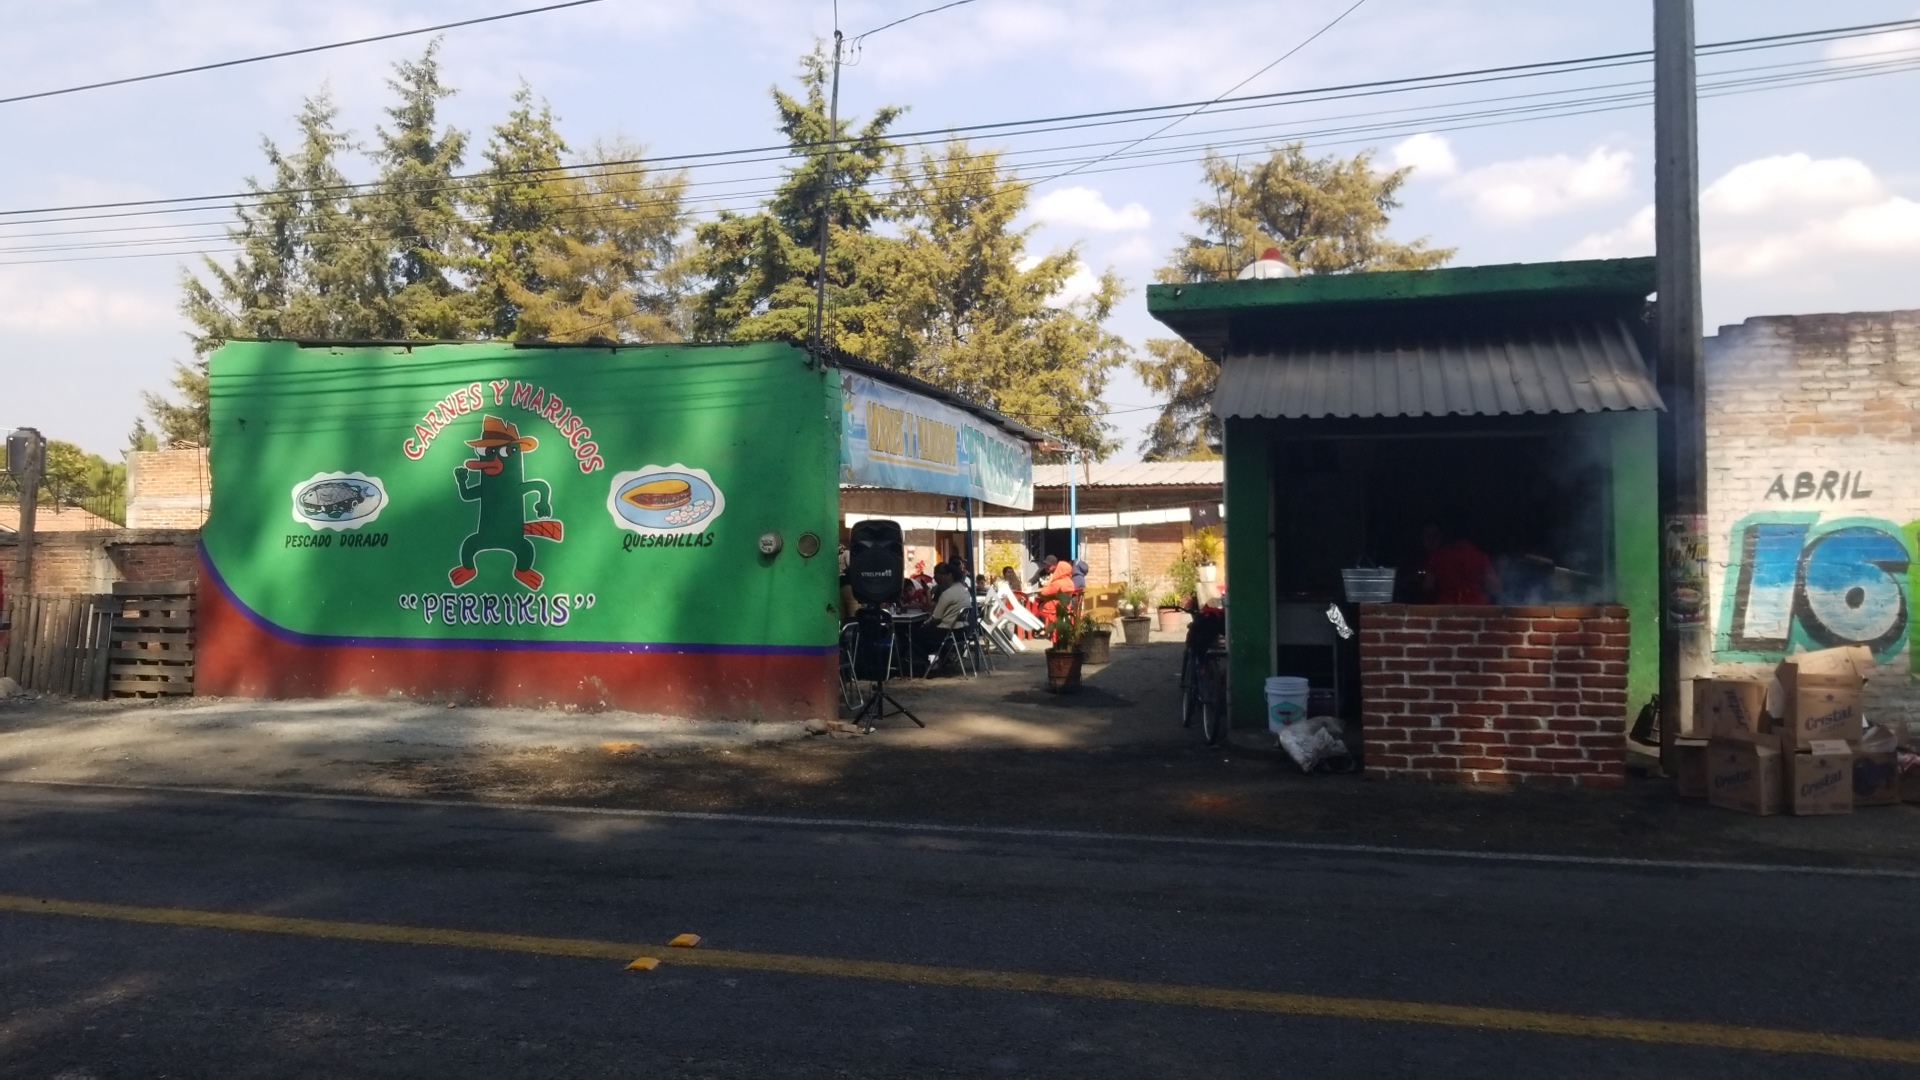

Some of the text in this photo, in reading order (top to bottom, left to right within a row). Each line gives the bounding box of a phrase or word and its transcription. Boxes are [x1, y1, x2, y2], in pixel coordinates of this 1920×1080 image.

[403, 379, 604, 474] CARNES Y MARISCOS
[1764, 470, 1873, 501] ABRIL
[285, 533, 389, 548] PESCADO DORADO
[622, 532, 715, 553] QUESADILLAS
[1728, 521, 1911, 656] 16
[1804, 705, 1853, 731] Cristal
[1801, 769, 1843, 797] Cristal
